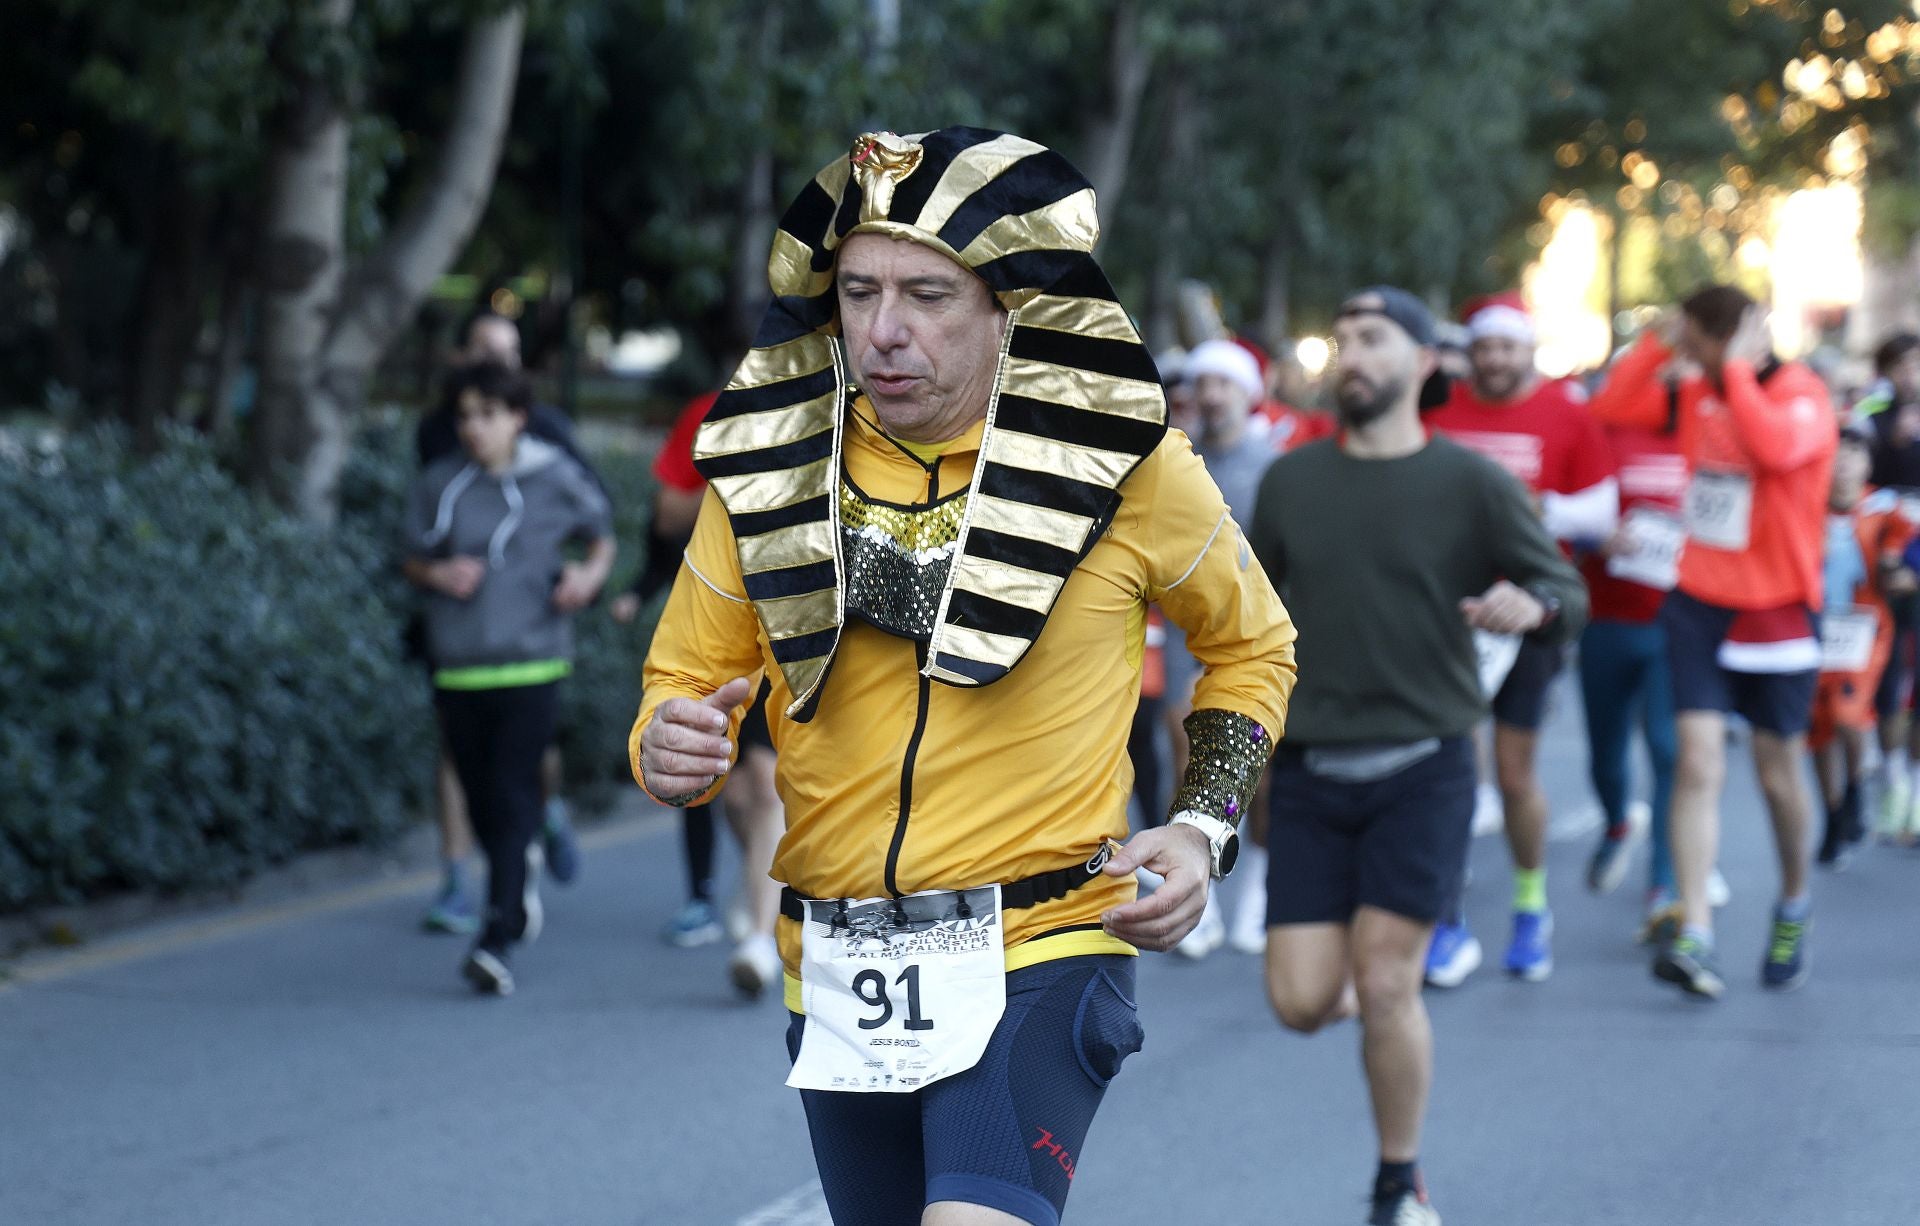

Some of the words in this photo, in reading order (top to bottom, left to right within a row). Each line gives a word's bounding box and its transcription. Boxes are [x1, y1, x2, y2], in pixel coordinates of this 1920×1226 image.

[932, 913, 995, 932] XIV
[883, 941, 905, 952] SAN
[909, 934, 990, 946] SILVESTRE
[915, 928, 990, 940] CARRERA
[847, 950, 901, 959] PALMA
[905, 940, 990, 952] PALMILLA
[851, 964, 934, 1031] 91
